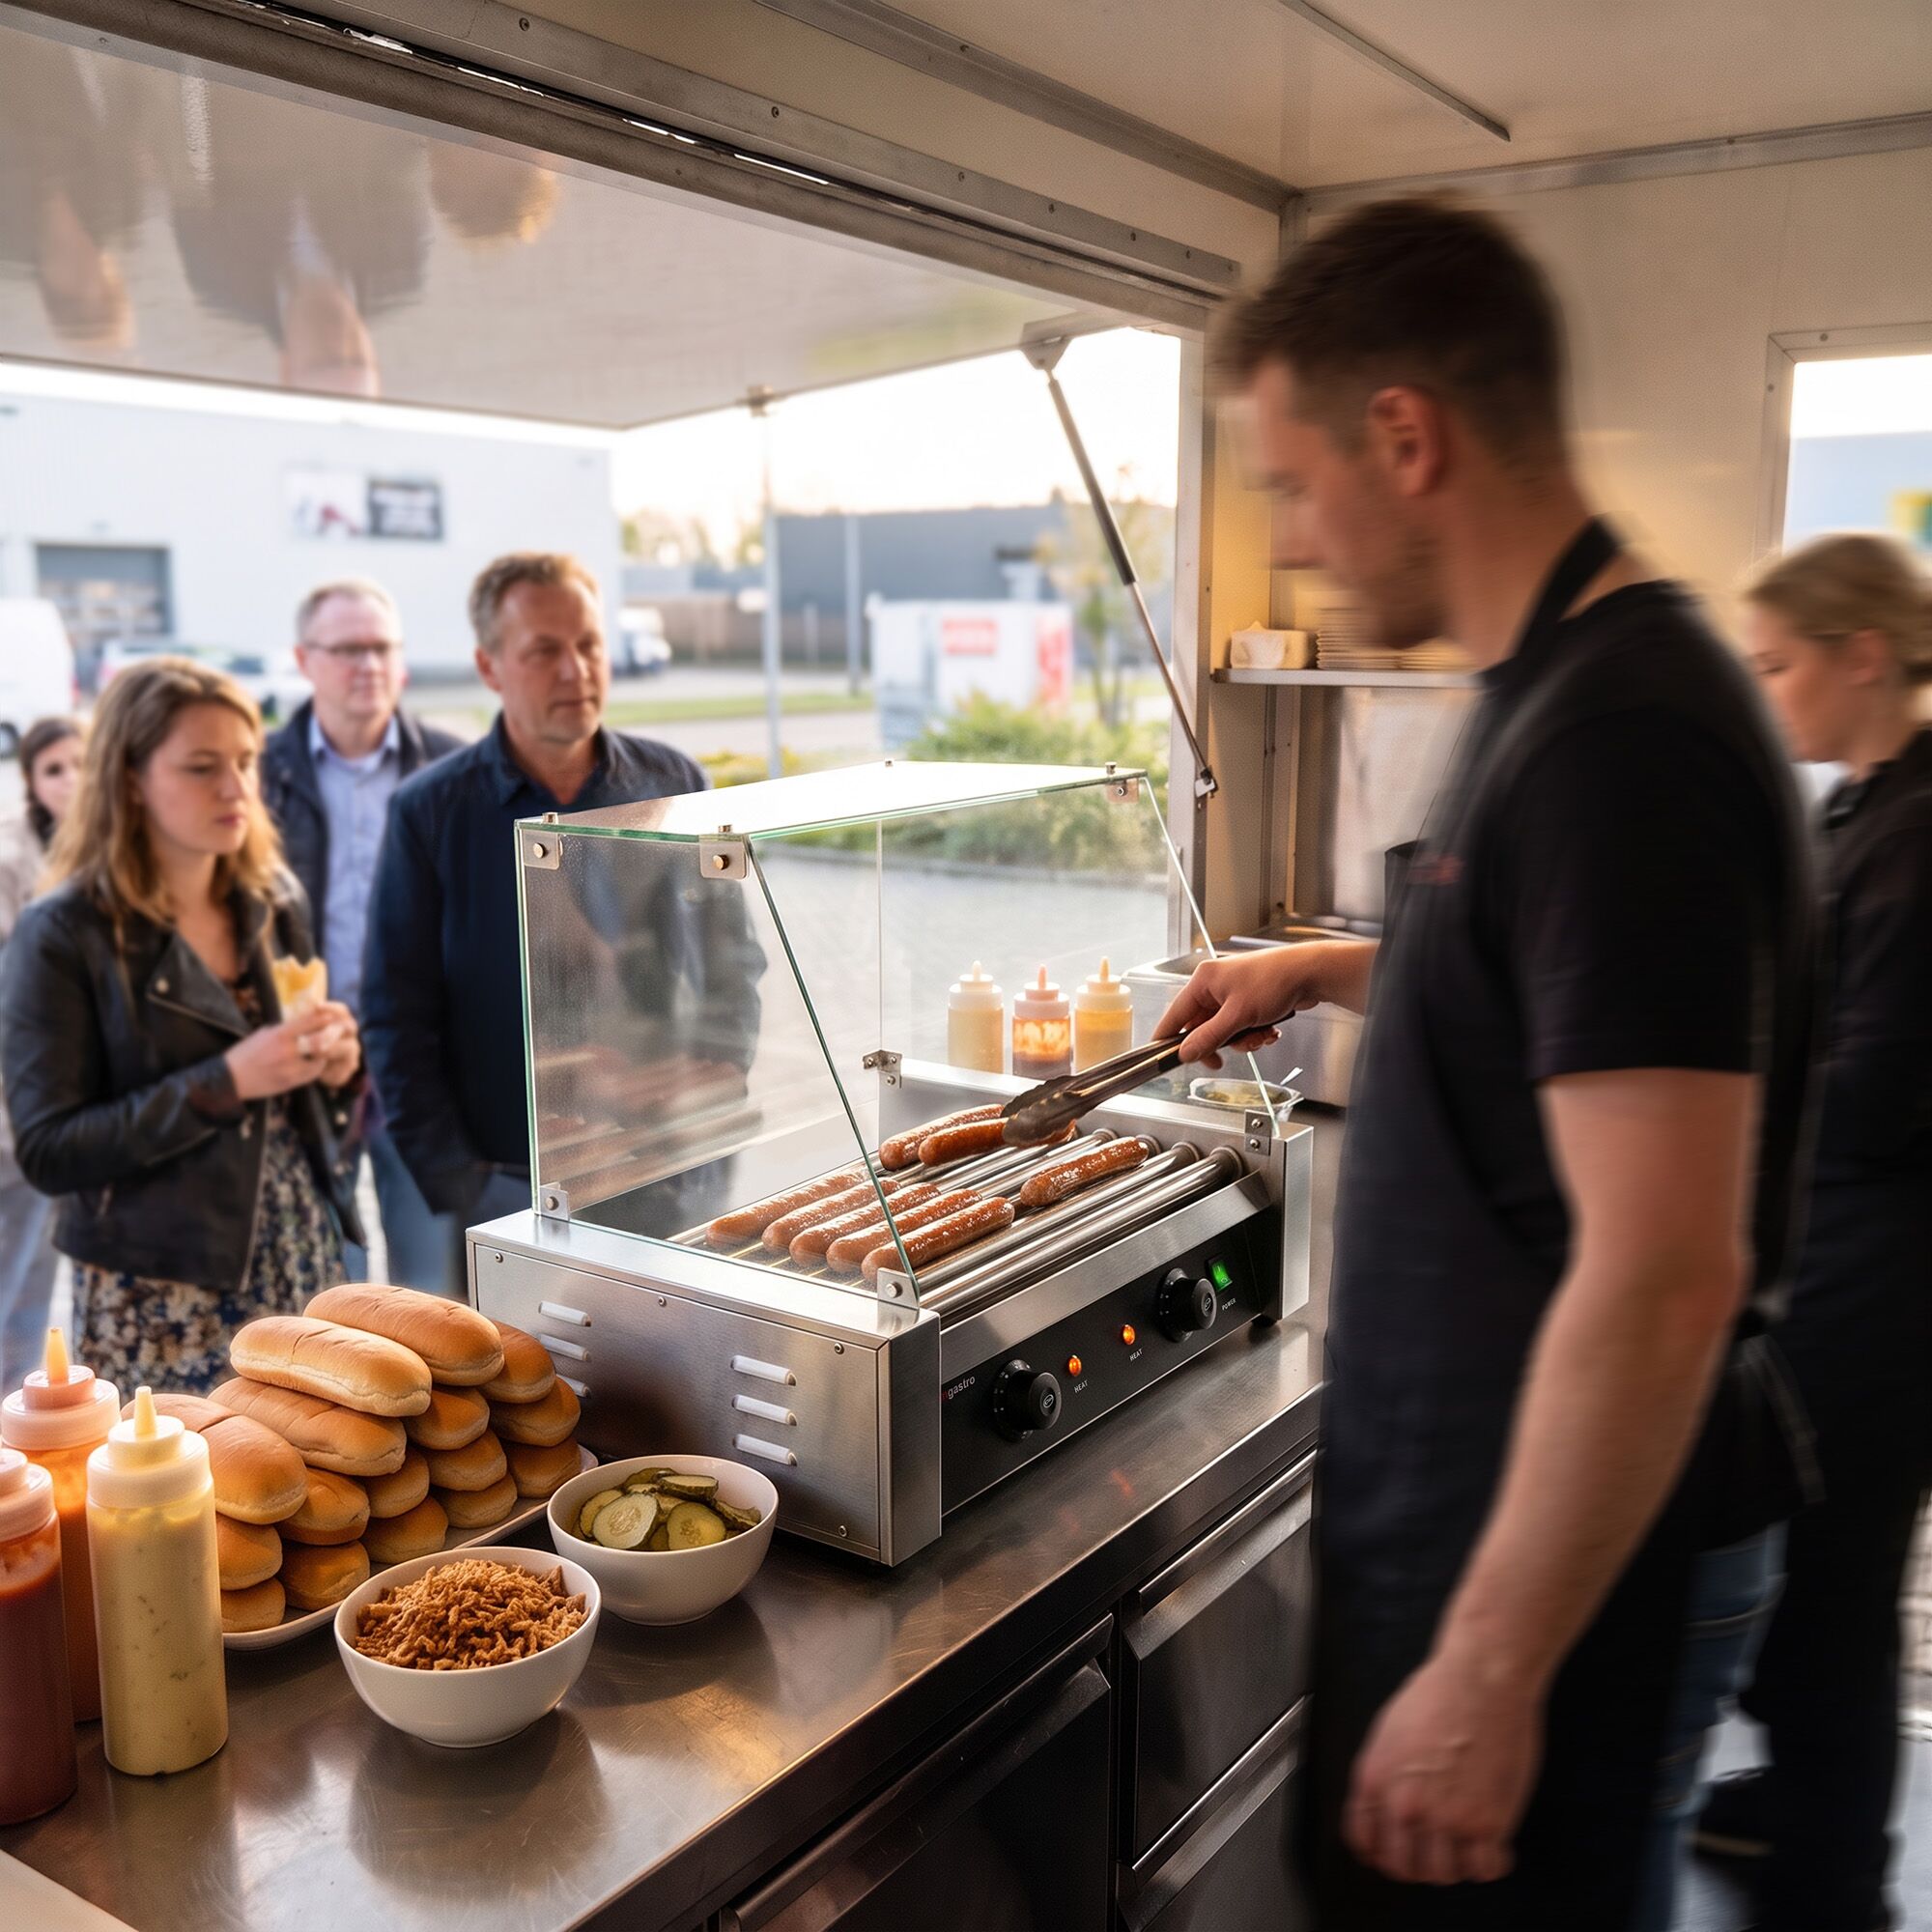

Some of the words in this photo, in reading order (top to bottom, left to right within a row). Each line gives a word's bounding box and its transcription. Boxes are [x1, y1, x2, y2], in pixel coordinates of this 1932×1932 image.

[1221, 1297, 1236, 1311] POWER
[1129, 1348, 1143, 1362] HEAT
[1073, 1378, 1088, 1394] HEAT
